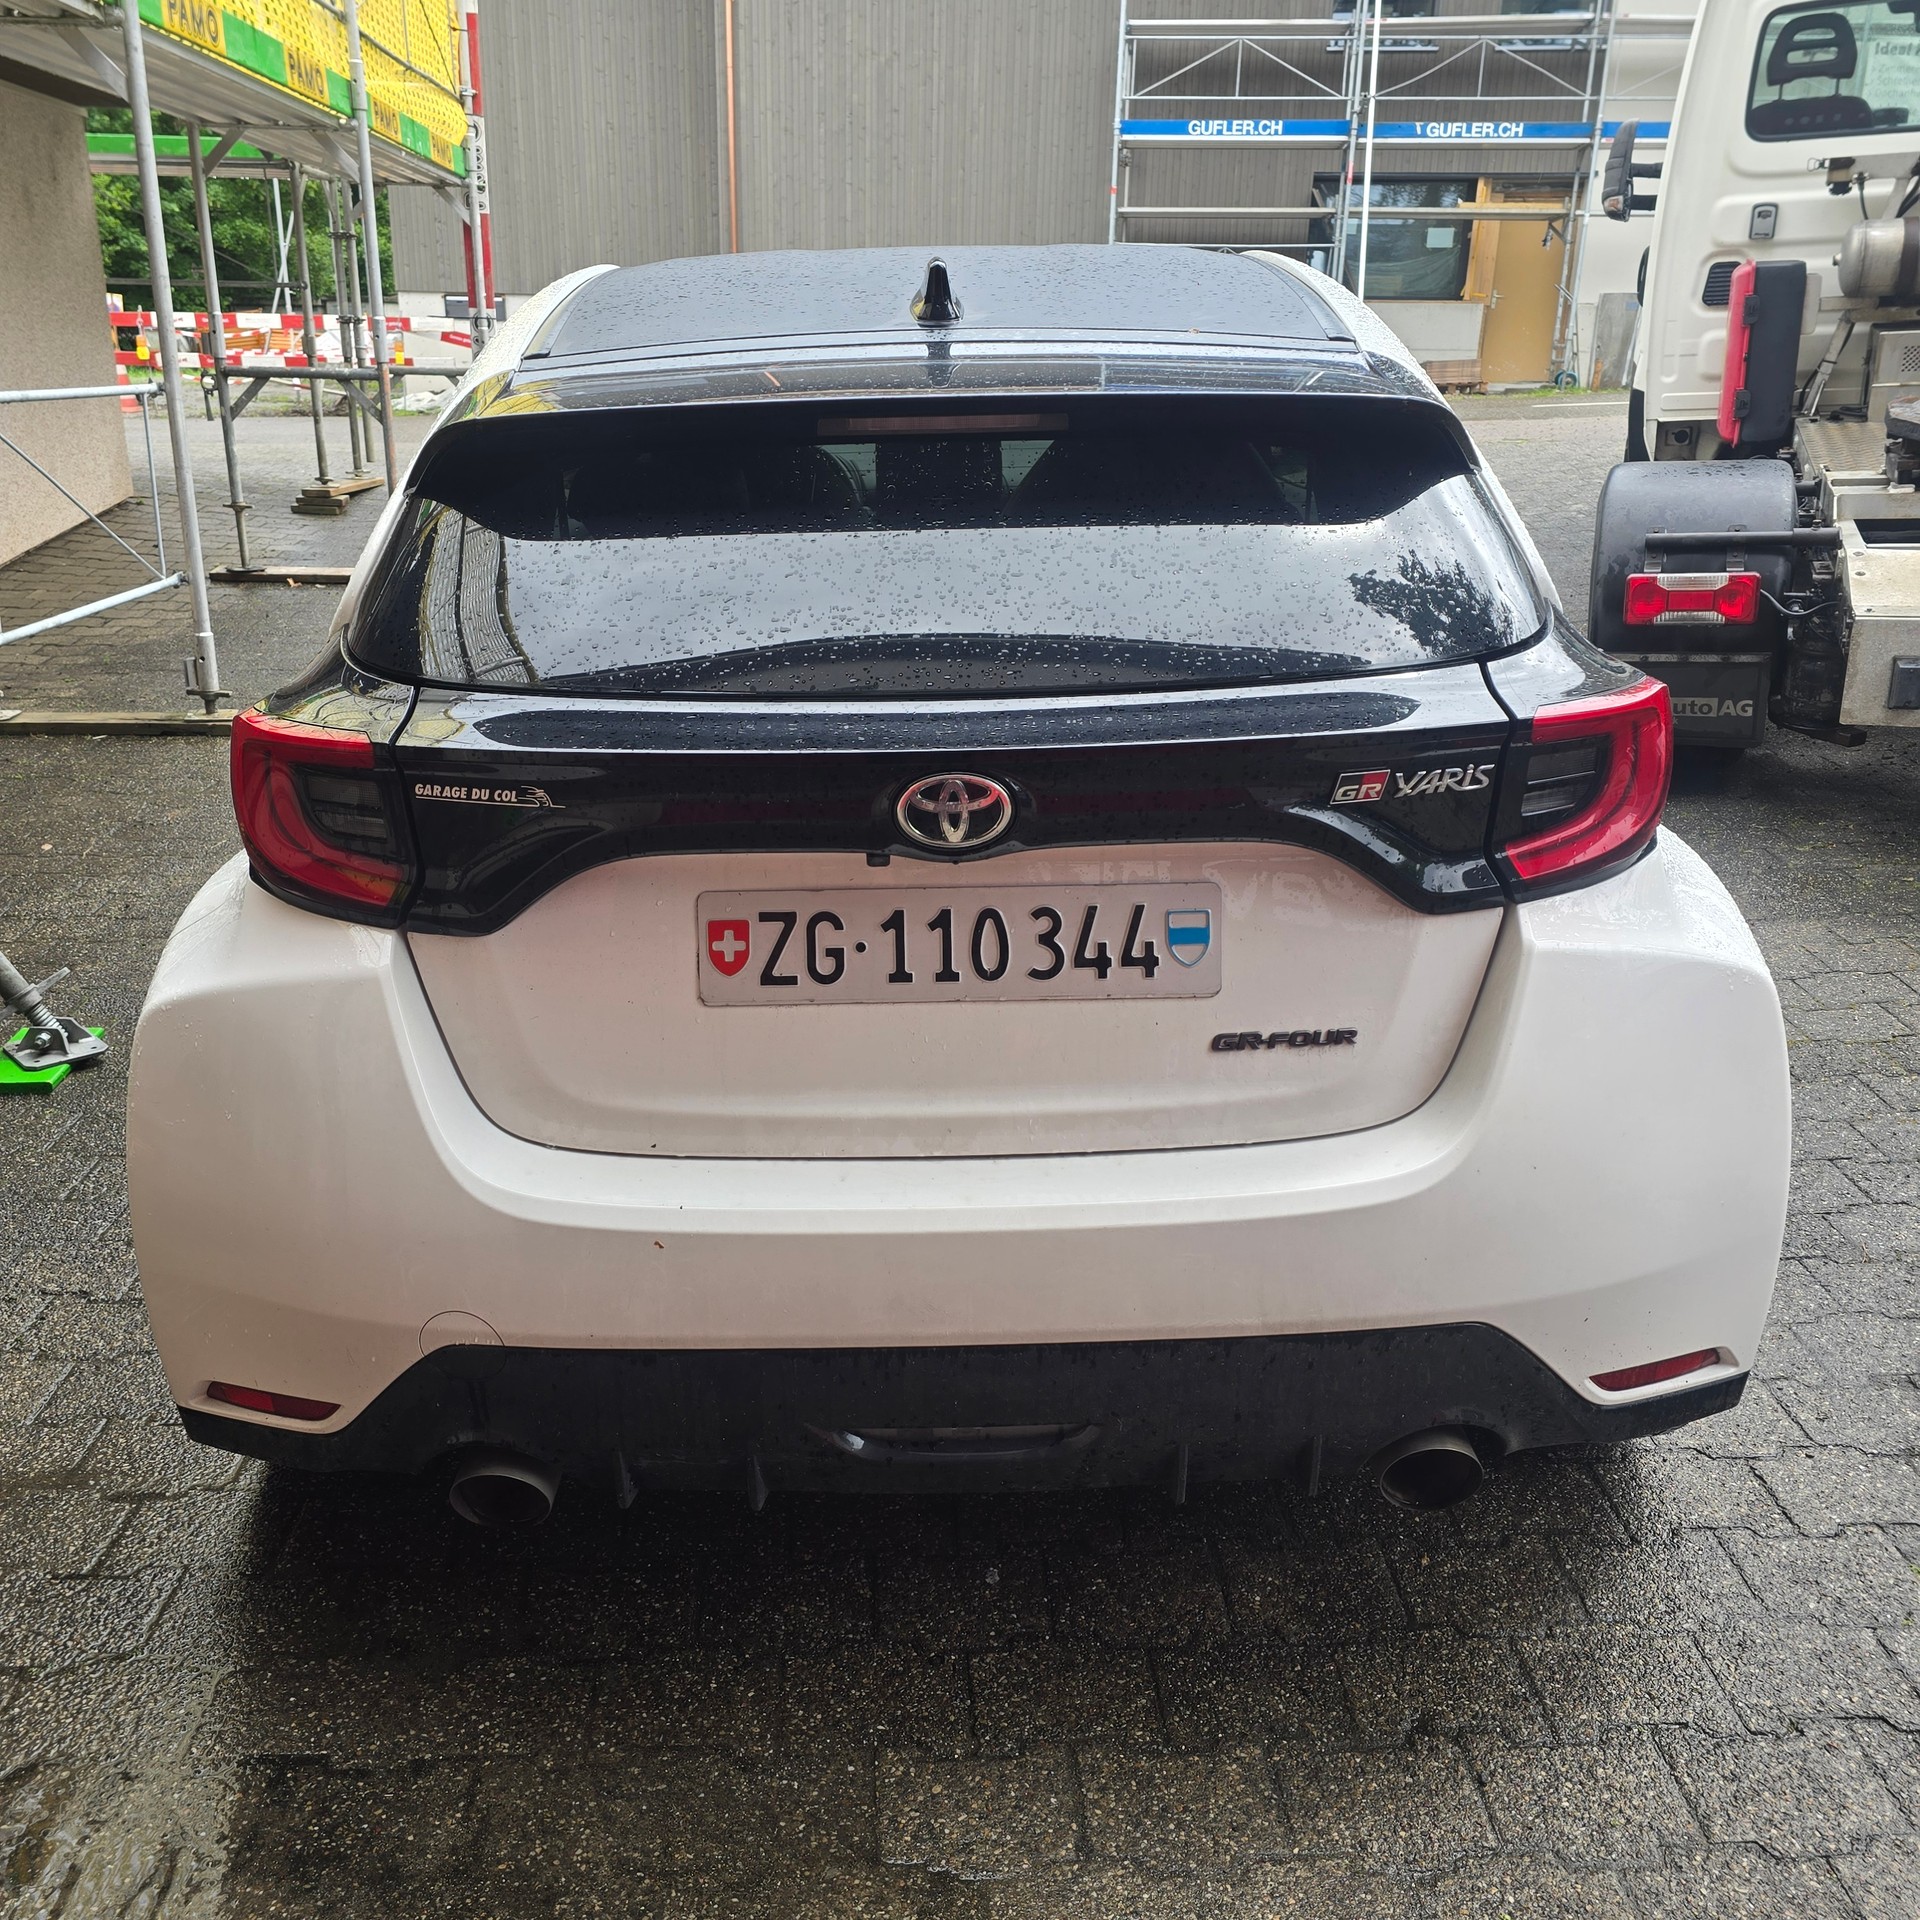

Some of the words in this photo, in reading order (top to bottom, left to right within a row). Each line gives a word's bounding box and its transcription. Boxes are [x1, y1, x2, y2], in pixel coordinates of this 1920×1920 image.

[167, 0, 219, 47] PAMO
[288, 49, 325, 98] PAMO
[1188, 120, 1283, 135] GUFLER.CH
[1426, 122, 1524, 137] GUFLER.CH
[1719, 700, 1753, 716] AG
[415, 783, 467, 799] GARAGE
[471, 788, 490, 800] DU
[494, 790, 518, 802] COL
[1334, 783, 1382, 801] GR
